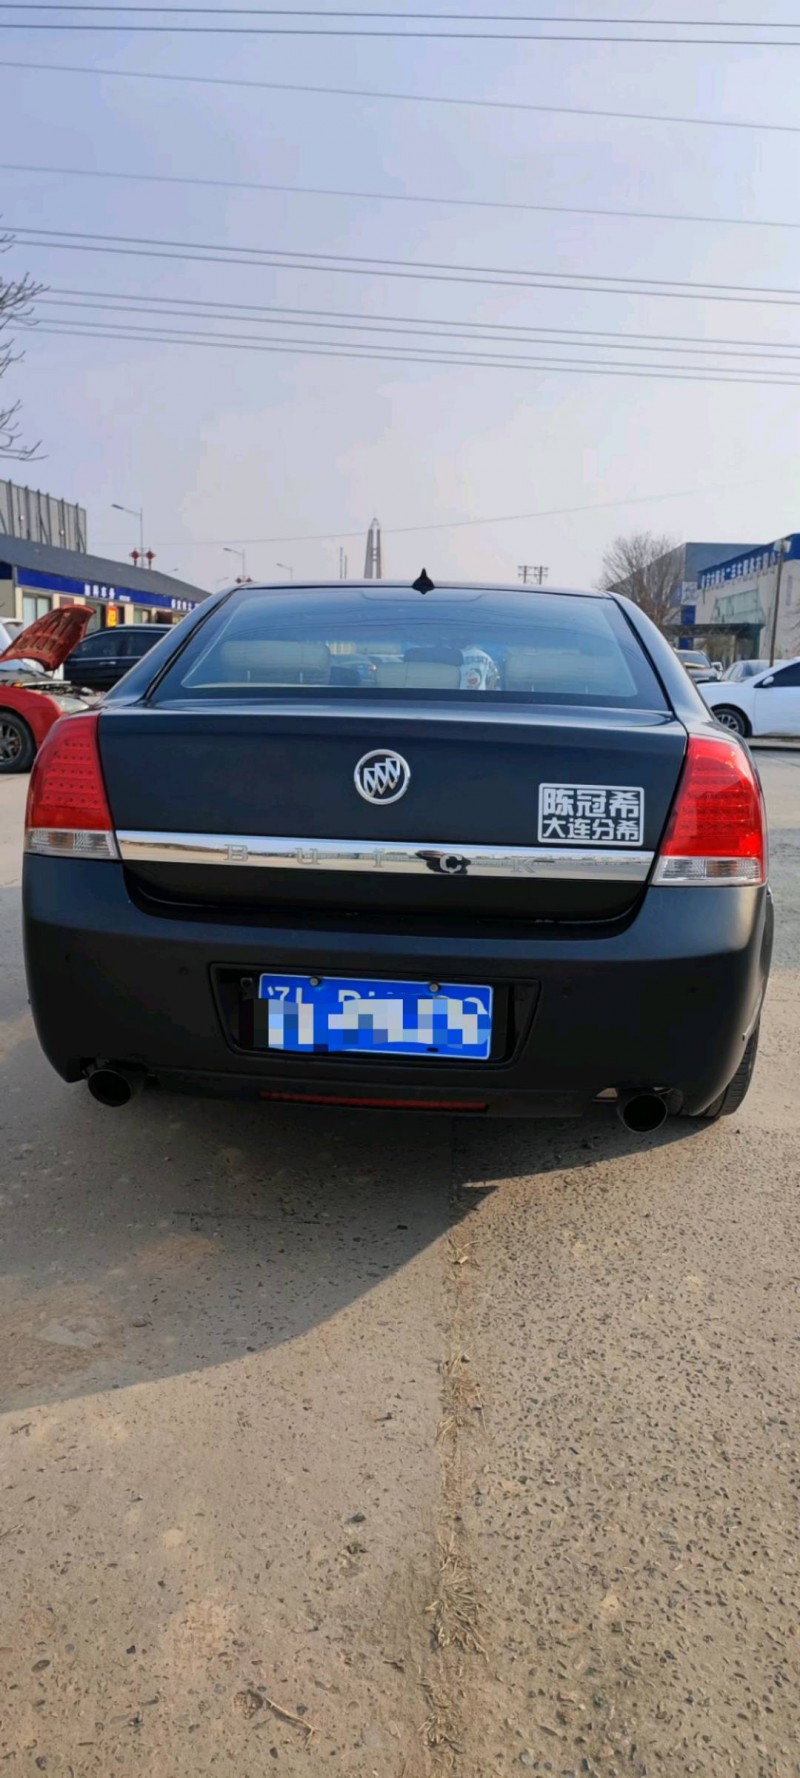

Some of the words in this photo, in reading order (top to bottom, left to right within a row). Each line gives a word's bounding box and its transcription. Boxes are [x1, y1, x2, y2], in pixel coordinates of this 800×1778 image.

[543, 788, 639, 818] 陈冠希
[542, 817, 639, 840] 大连分希
[224, 844, 535, 873] BUICK
